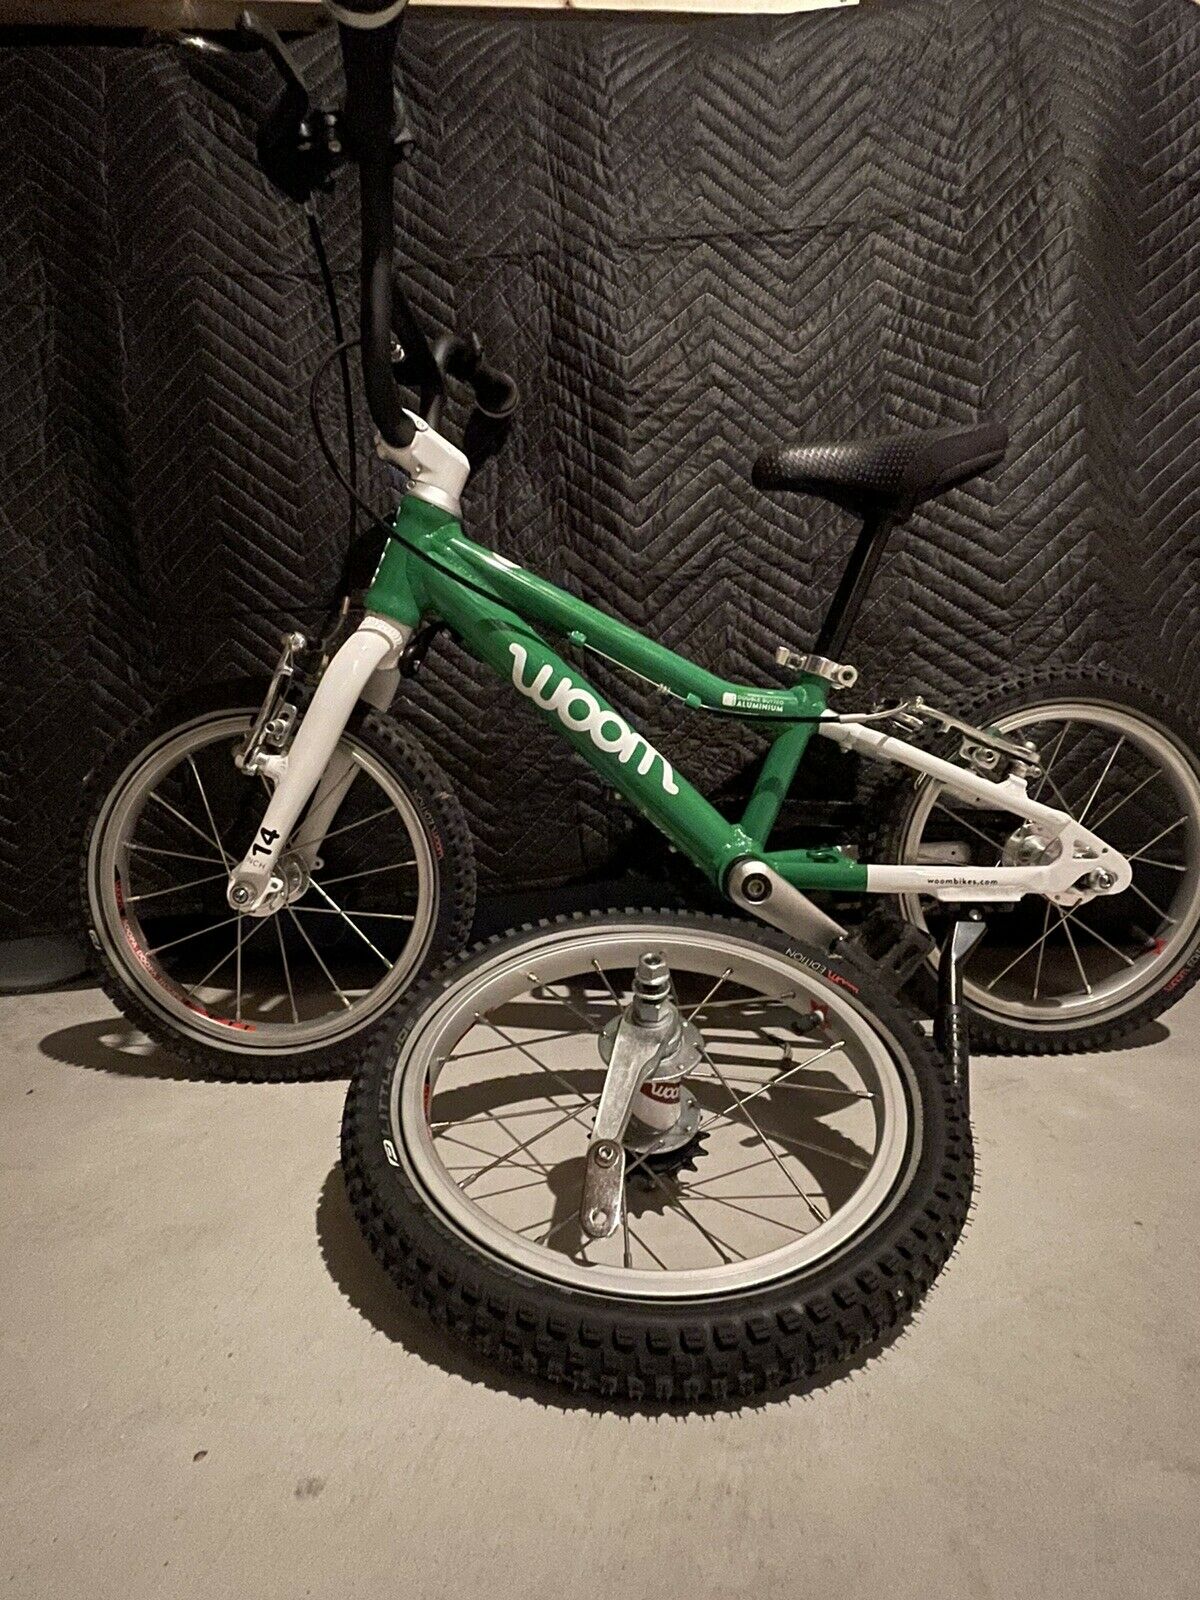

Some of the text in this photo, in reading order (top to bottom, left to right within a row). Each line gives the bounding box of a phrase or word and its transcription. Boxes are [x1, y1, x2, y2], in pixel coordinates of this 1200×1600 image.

[736, 700, 784, 713] ALUMINIUM
[508, 642, 680, 796] woom
[252, 826, 280, 856] 14
[927, 877, 999, 887] woombikes.com
[784, 947, 828, 975] EDITION
[651, 1081, 680, 1099] woo
